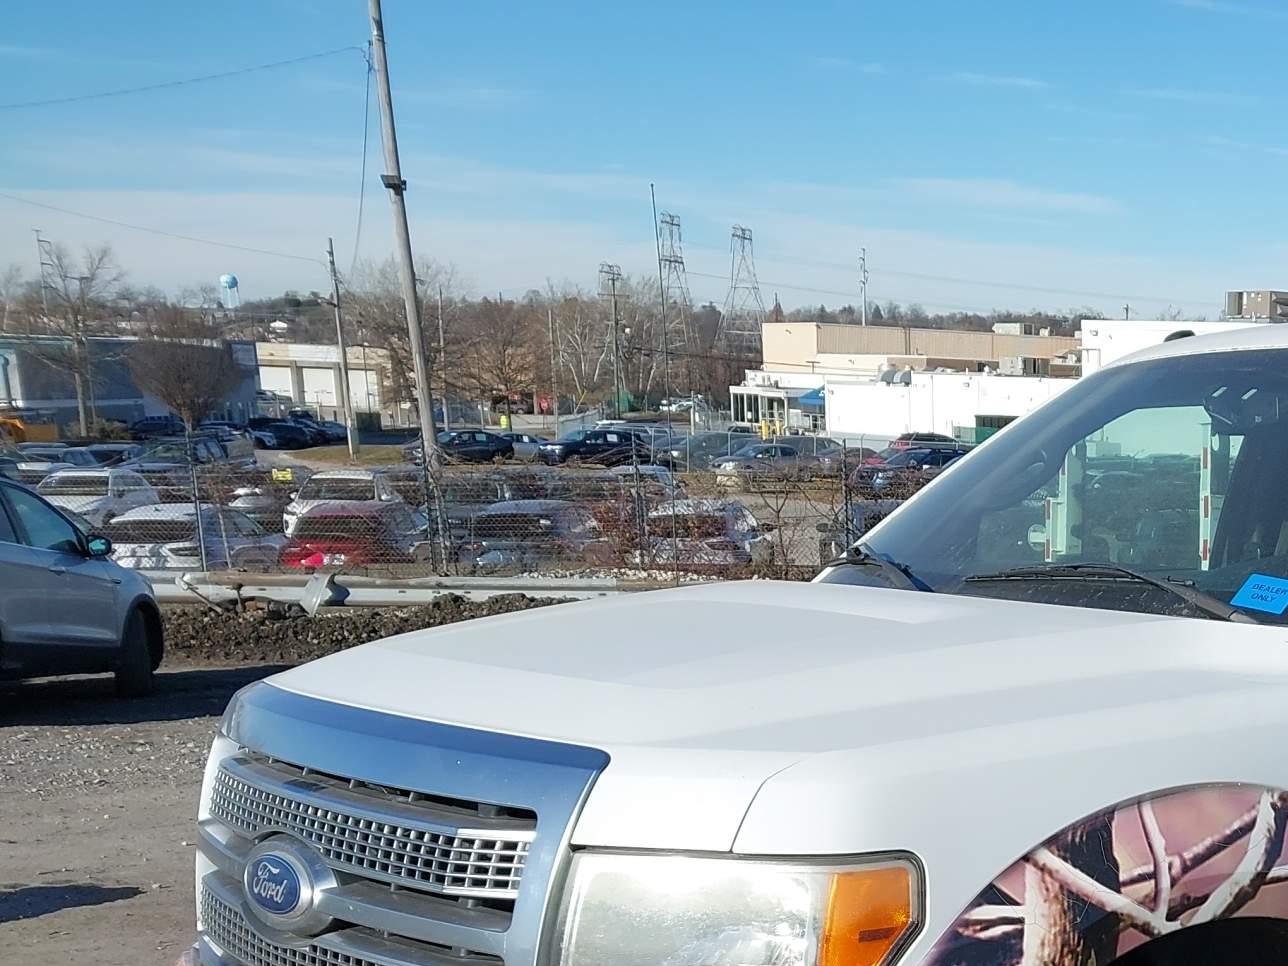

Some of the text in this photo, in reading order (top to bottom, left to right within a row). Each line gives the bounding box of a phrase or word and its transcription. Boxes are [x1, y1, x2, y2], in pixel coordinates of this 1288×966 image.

[1252, 583, 1288, 595] DEALER
[1250, 593, 1277, 603] ONLY
[253, 861, 288, 904] Ford
